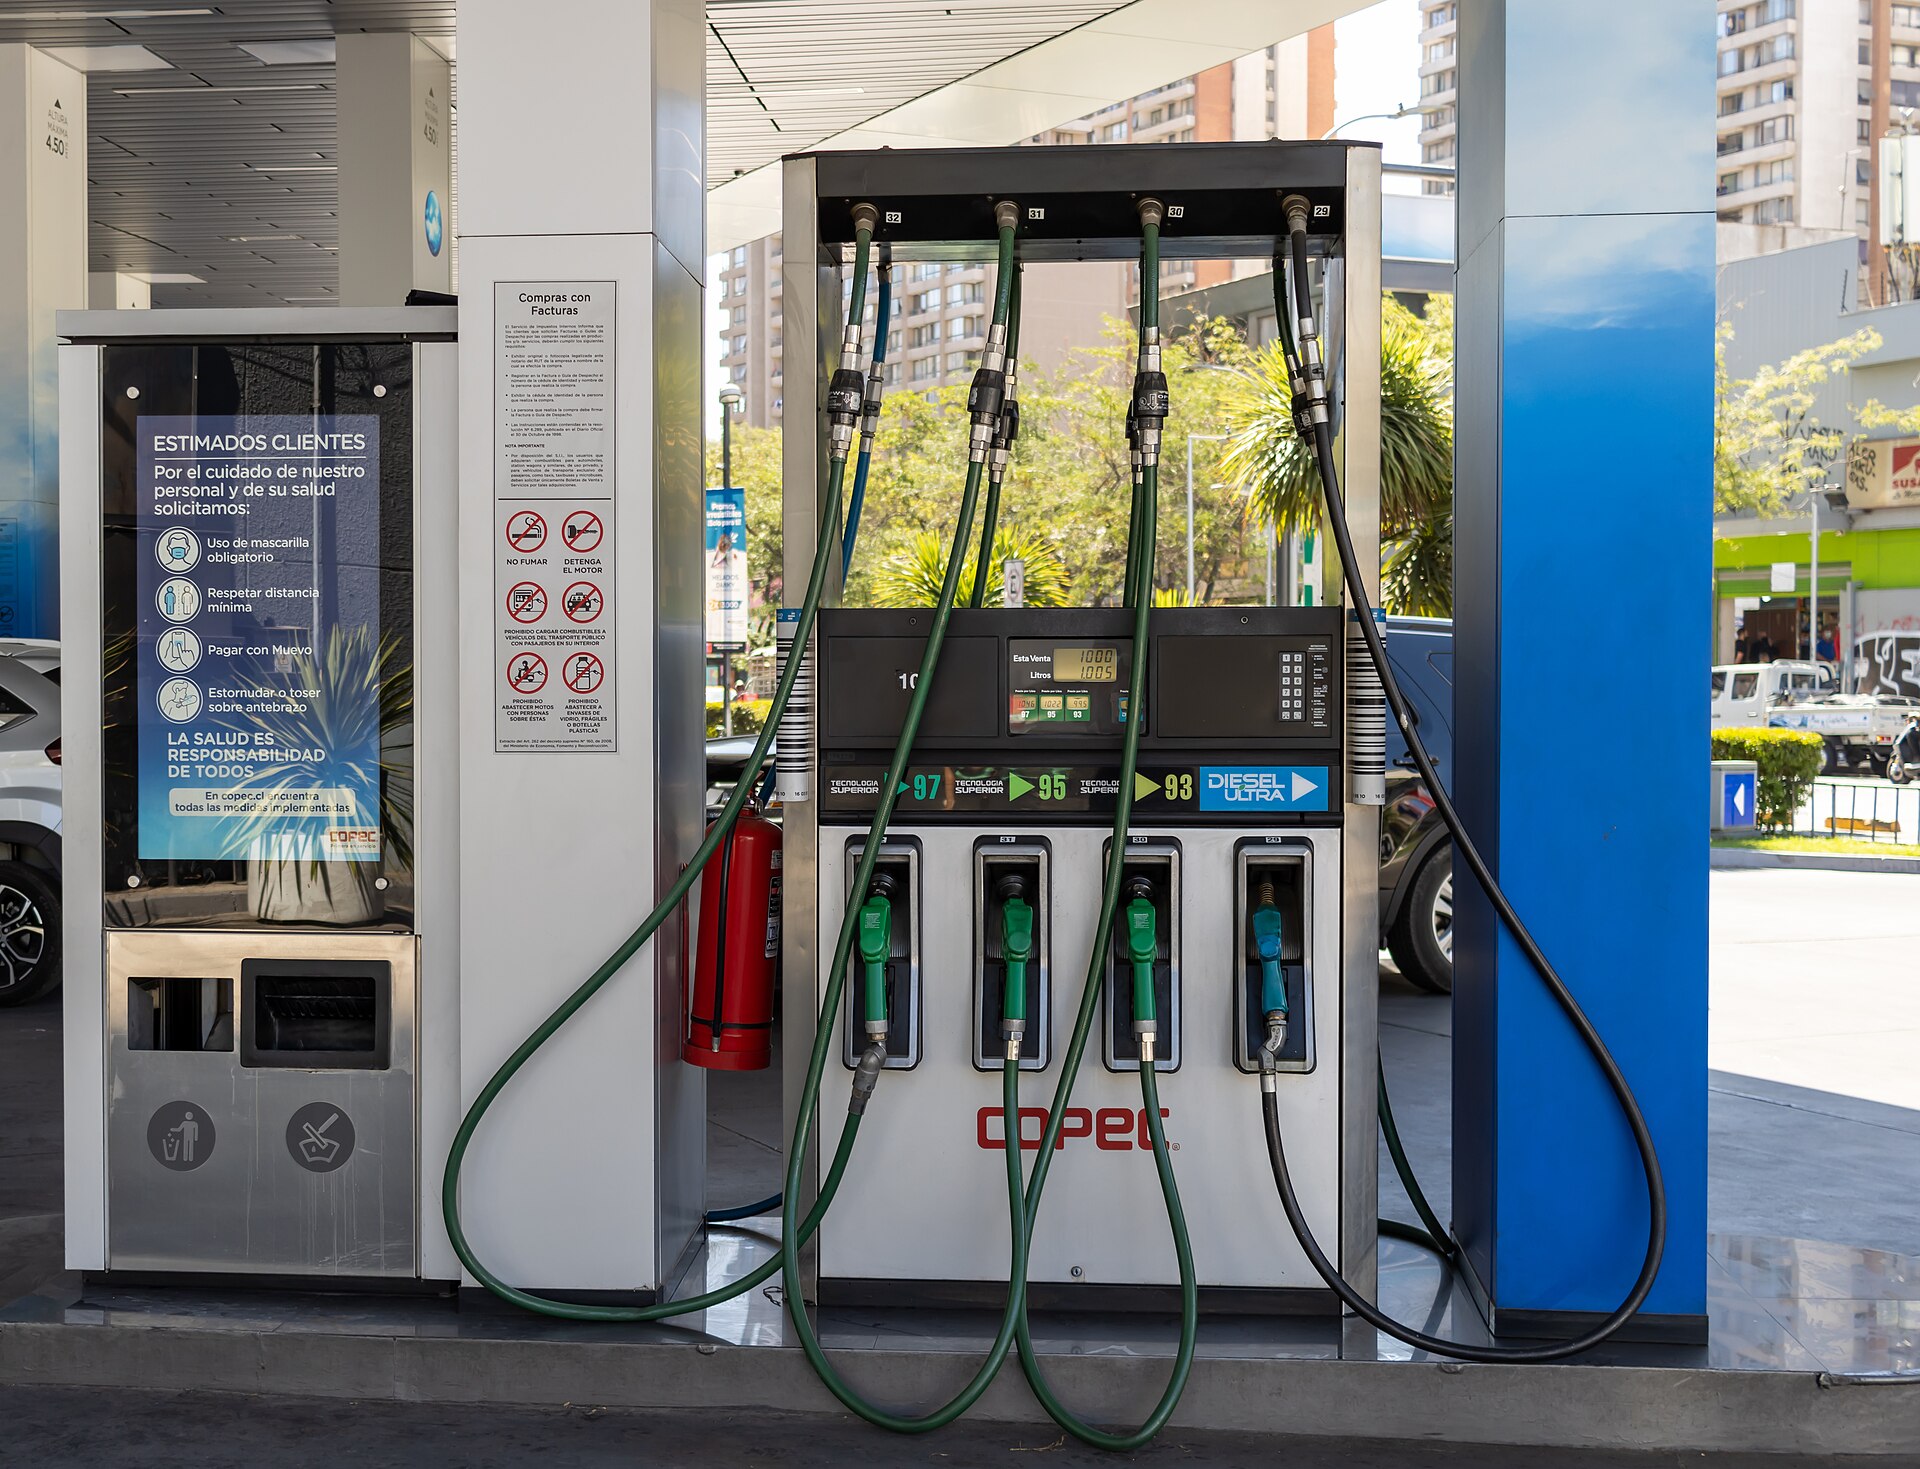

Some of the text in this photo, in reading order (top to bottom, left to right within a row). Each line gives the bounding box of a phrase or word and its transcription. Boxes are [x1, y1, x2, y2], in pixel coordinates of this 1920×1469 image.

[46, 135, 64, 155] 4.50
[1170, 208, 1182, 216] 30
[519, 293, 567, 303] Compras
[532, 306, 578, 315] Facturas
[154, 434, 365, 451] ESTIMADOS CLIENTES
[155, 464, 365, 479] Por el cuidado de nuestro
[155, 482, 335, 499] personal y de su salud
[154, 501, 250, 515] solicitamos:
[207, 537, 309, 548] Uso de mascarilla
[207, 552, 273, 564] obligatorio
[208, 588, 319, 600] Respetar distancia
[208, 602, 252, 612] mínima
[208, 645, 243, 657] Pagar
[273, 645, 312, 655] Muevo
[1080, 650, 1112, 663] 1000
[1080, 666, 1112, 679] 1.005
[208, 688, 276, 698] Estornudar
[290, 689, 320, 698] toser
[208, 703, 307, 712] sobre antebrazo
[168, 733, 274, 745] LA SALUD ES
[168, 749, 325, 762] RESPONSABILIDAD
[168, 765, 254, 778] DE TODOS
[1165, 774, 1192, 800] 93
[1208, 774, 1285, 788] DIESEL
[914, 775, 941, 800] 97
[1039, 775, 1066, 800] 95
[221, 792, 264, 801] copec.cl
[1224, 789, 1285, 801] ULTRA
[176, 803, 350, 814] todas las medidas implementadas
